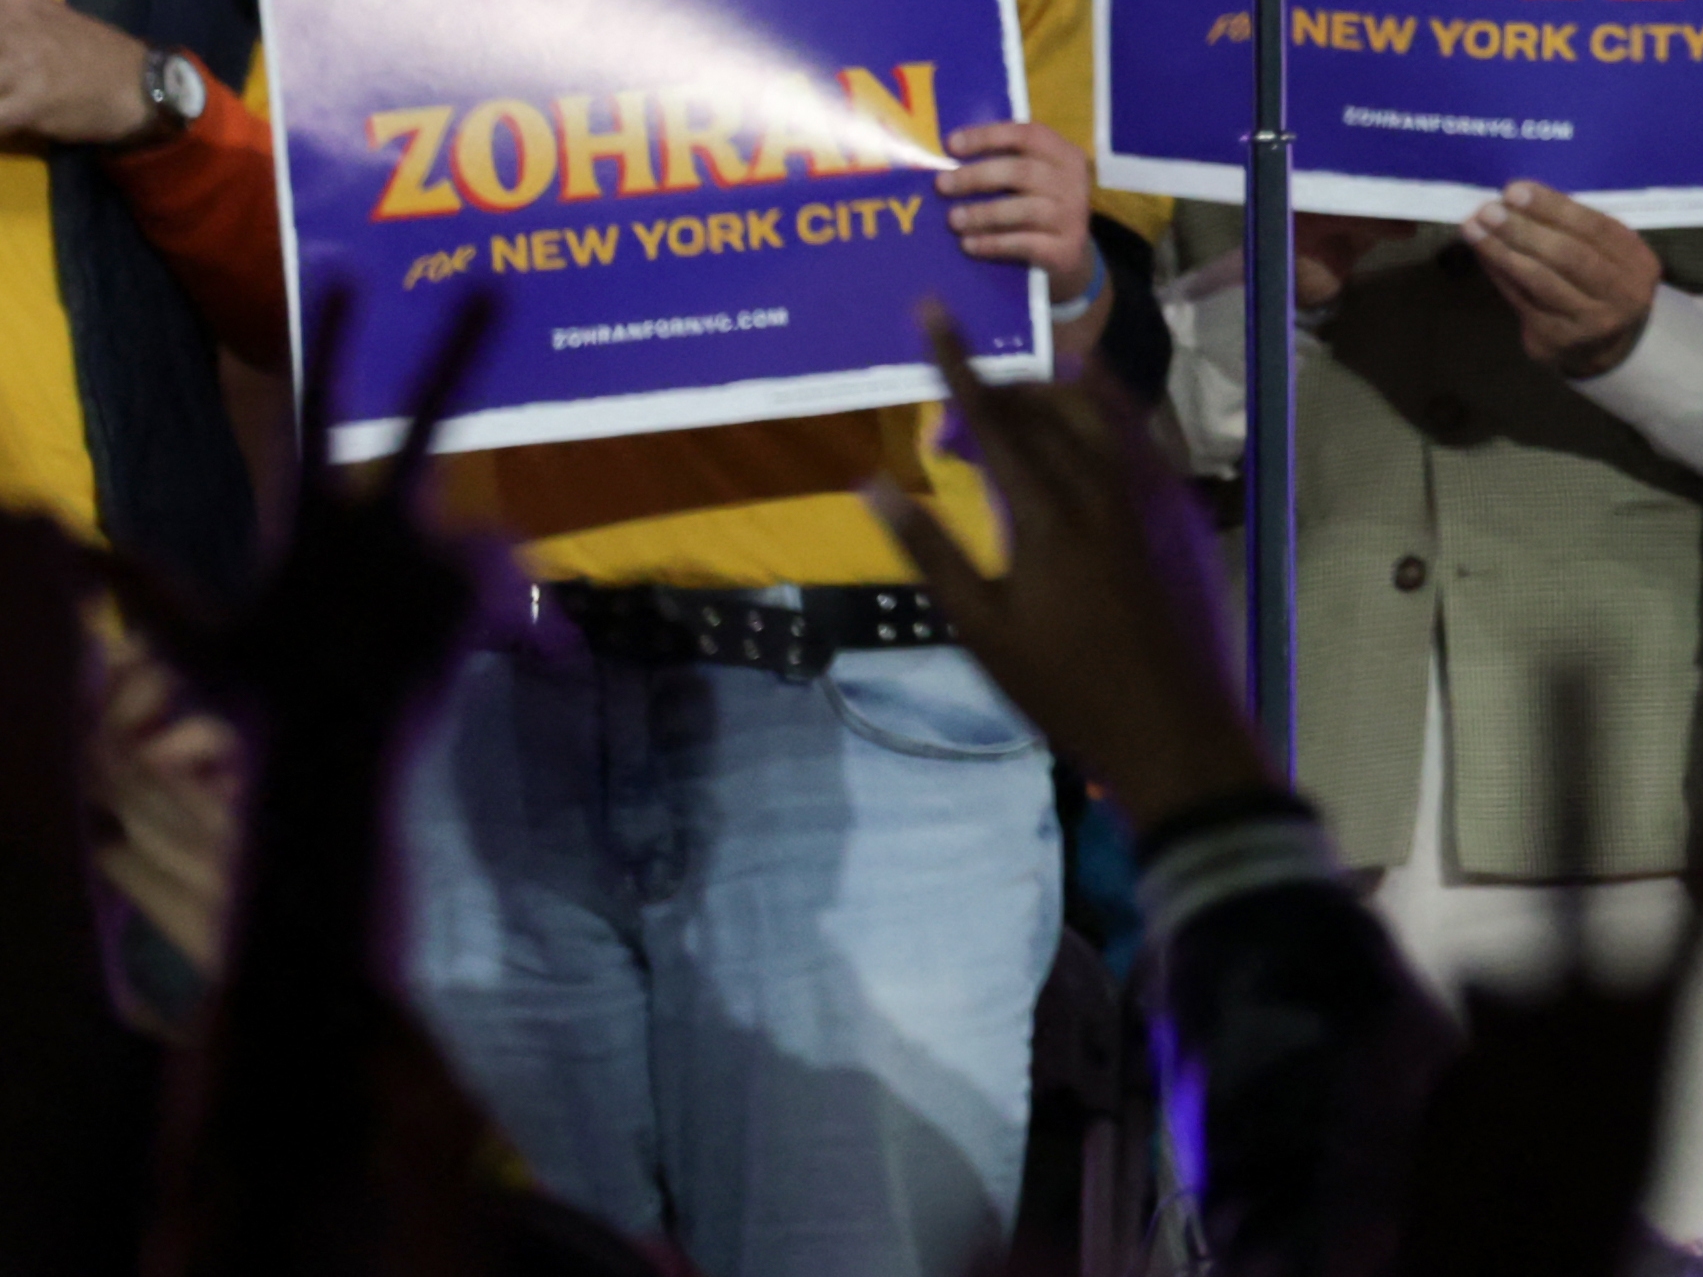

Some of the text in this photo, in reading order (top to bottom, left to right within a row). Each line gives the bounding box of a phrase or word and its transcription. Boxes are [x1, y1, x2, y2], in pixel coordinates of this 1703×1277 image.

[1291, 5, 1418, 57] NEW
[1428, 18, 1579, 64] YORK
[366, 61, 946, 224] ZOHRAN
[489, 224, 620, 276] NEW
[631, 207, 785, 262] YORK
[795, 196, 926, 243] CITY
[551, 305, 790, 351] ZOHRANFORNYC.COM
